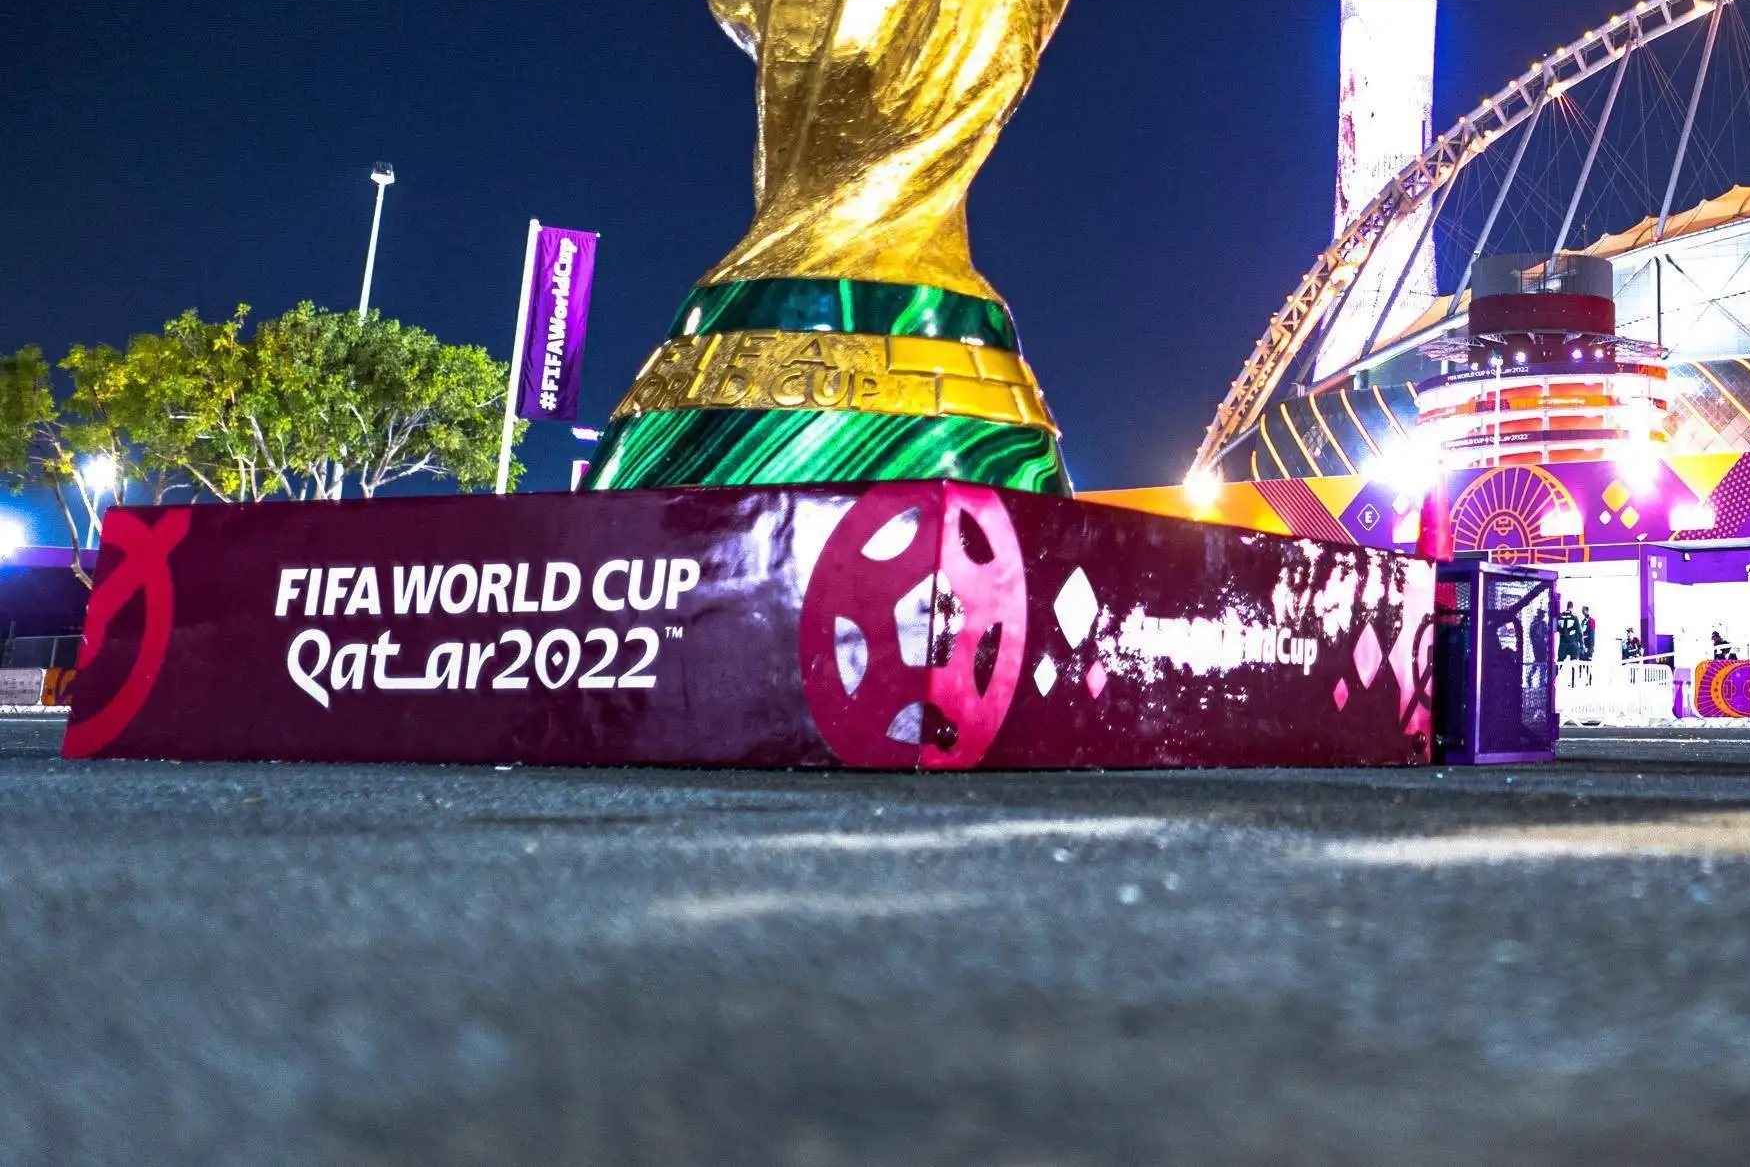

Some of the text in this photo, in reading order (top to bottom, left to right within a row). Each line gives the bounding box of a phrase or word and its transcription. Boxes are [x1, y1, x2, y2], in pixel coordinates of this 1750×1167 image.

[770, 368, 885, 408] CUP
[1365, 511, 1373, 524] E
[275, 558, 701, 616] FIFA WORLD CUP
